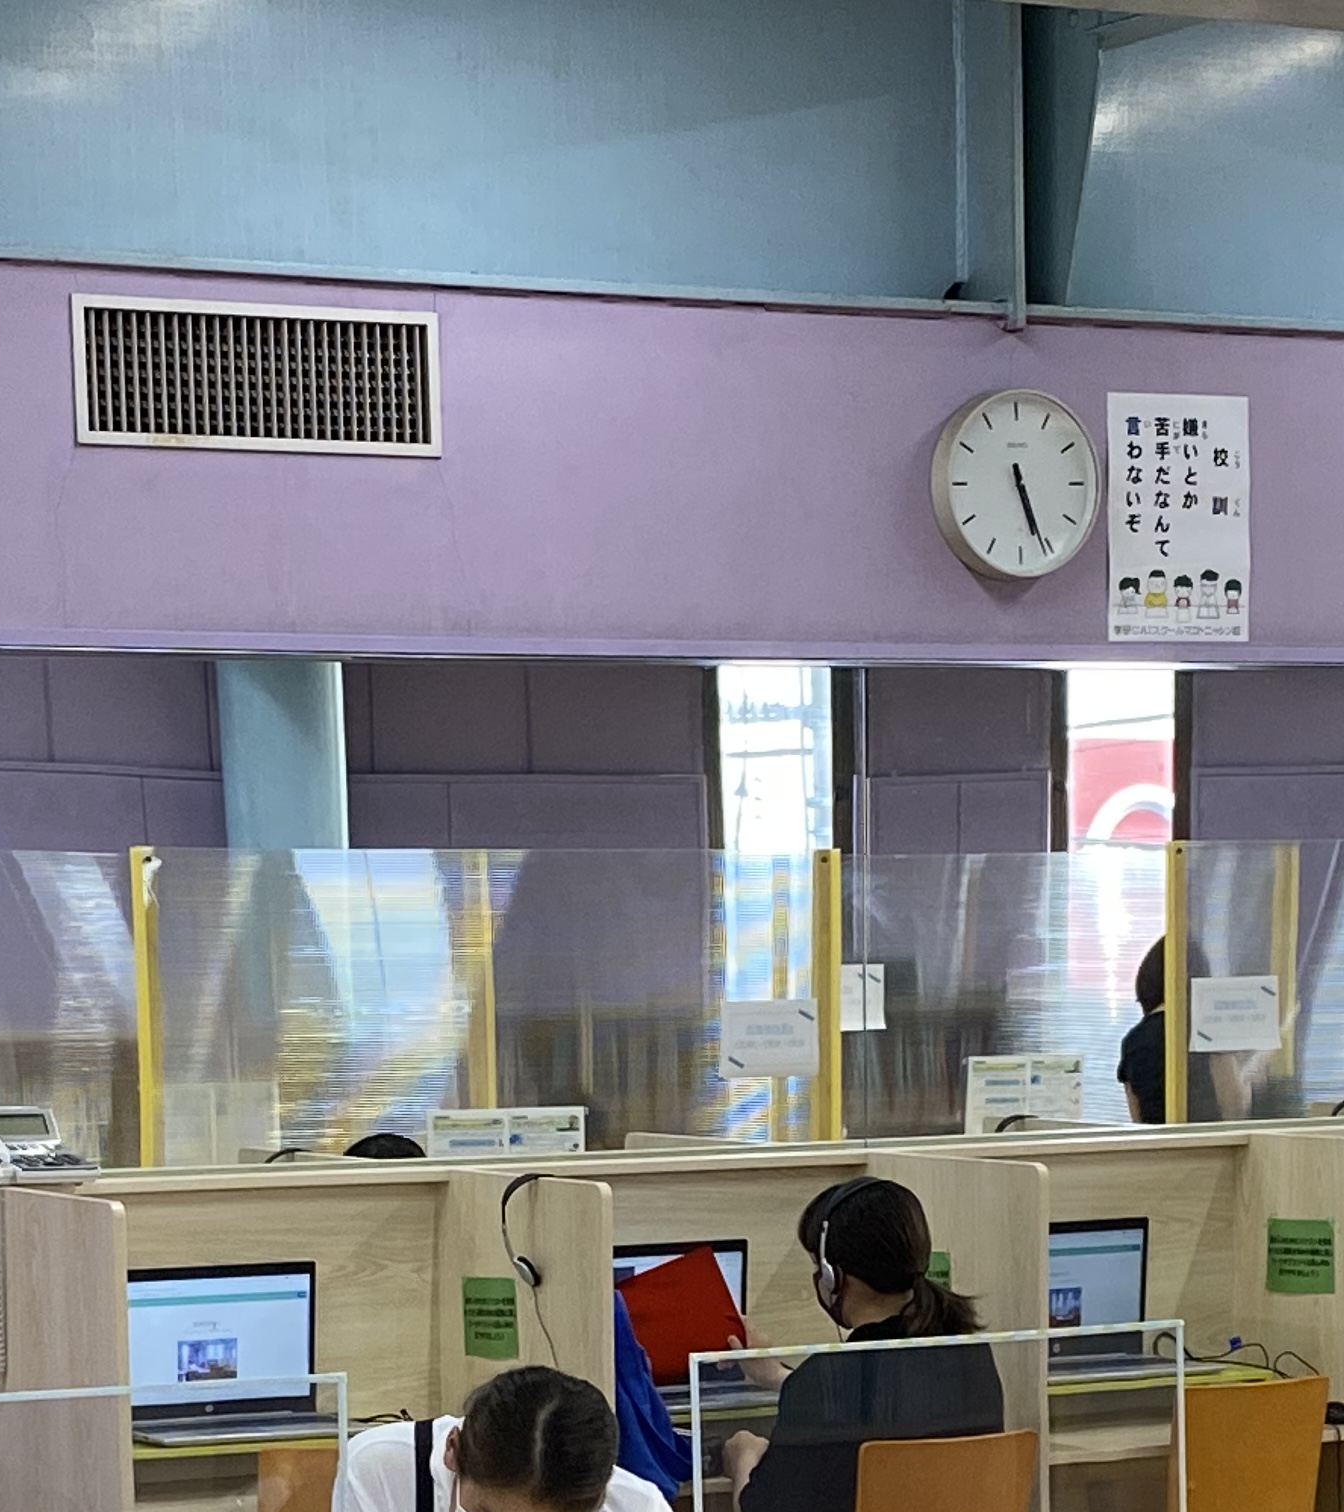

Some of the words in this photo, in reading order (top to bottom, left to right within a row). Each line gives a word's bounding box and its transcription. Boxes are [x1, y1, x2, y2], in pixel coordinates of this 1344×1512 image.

[1125, 416, 1143, 533] 言わないぞ
[1154, 417, 1171, 557] 苦手だなんて
[1182, 417, 1199, 509] 嫌いとか
